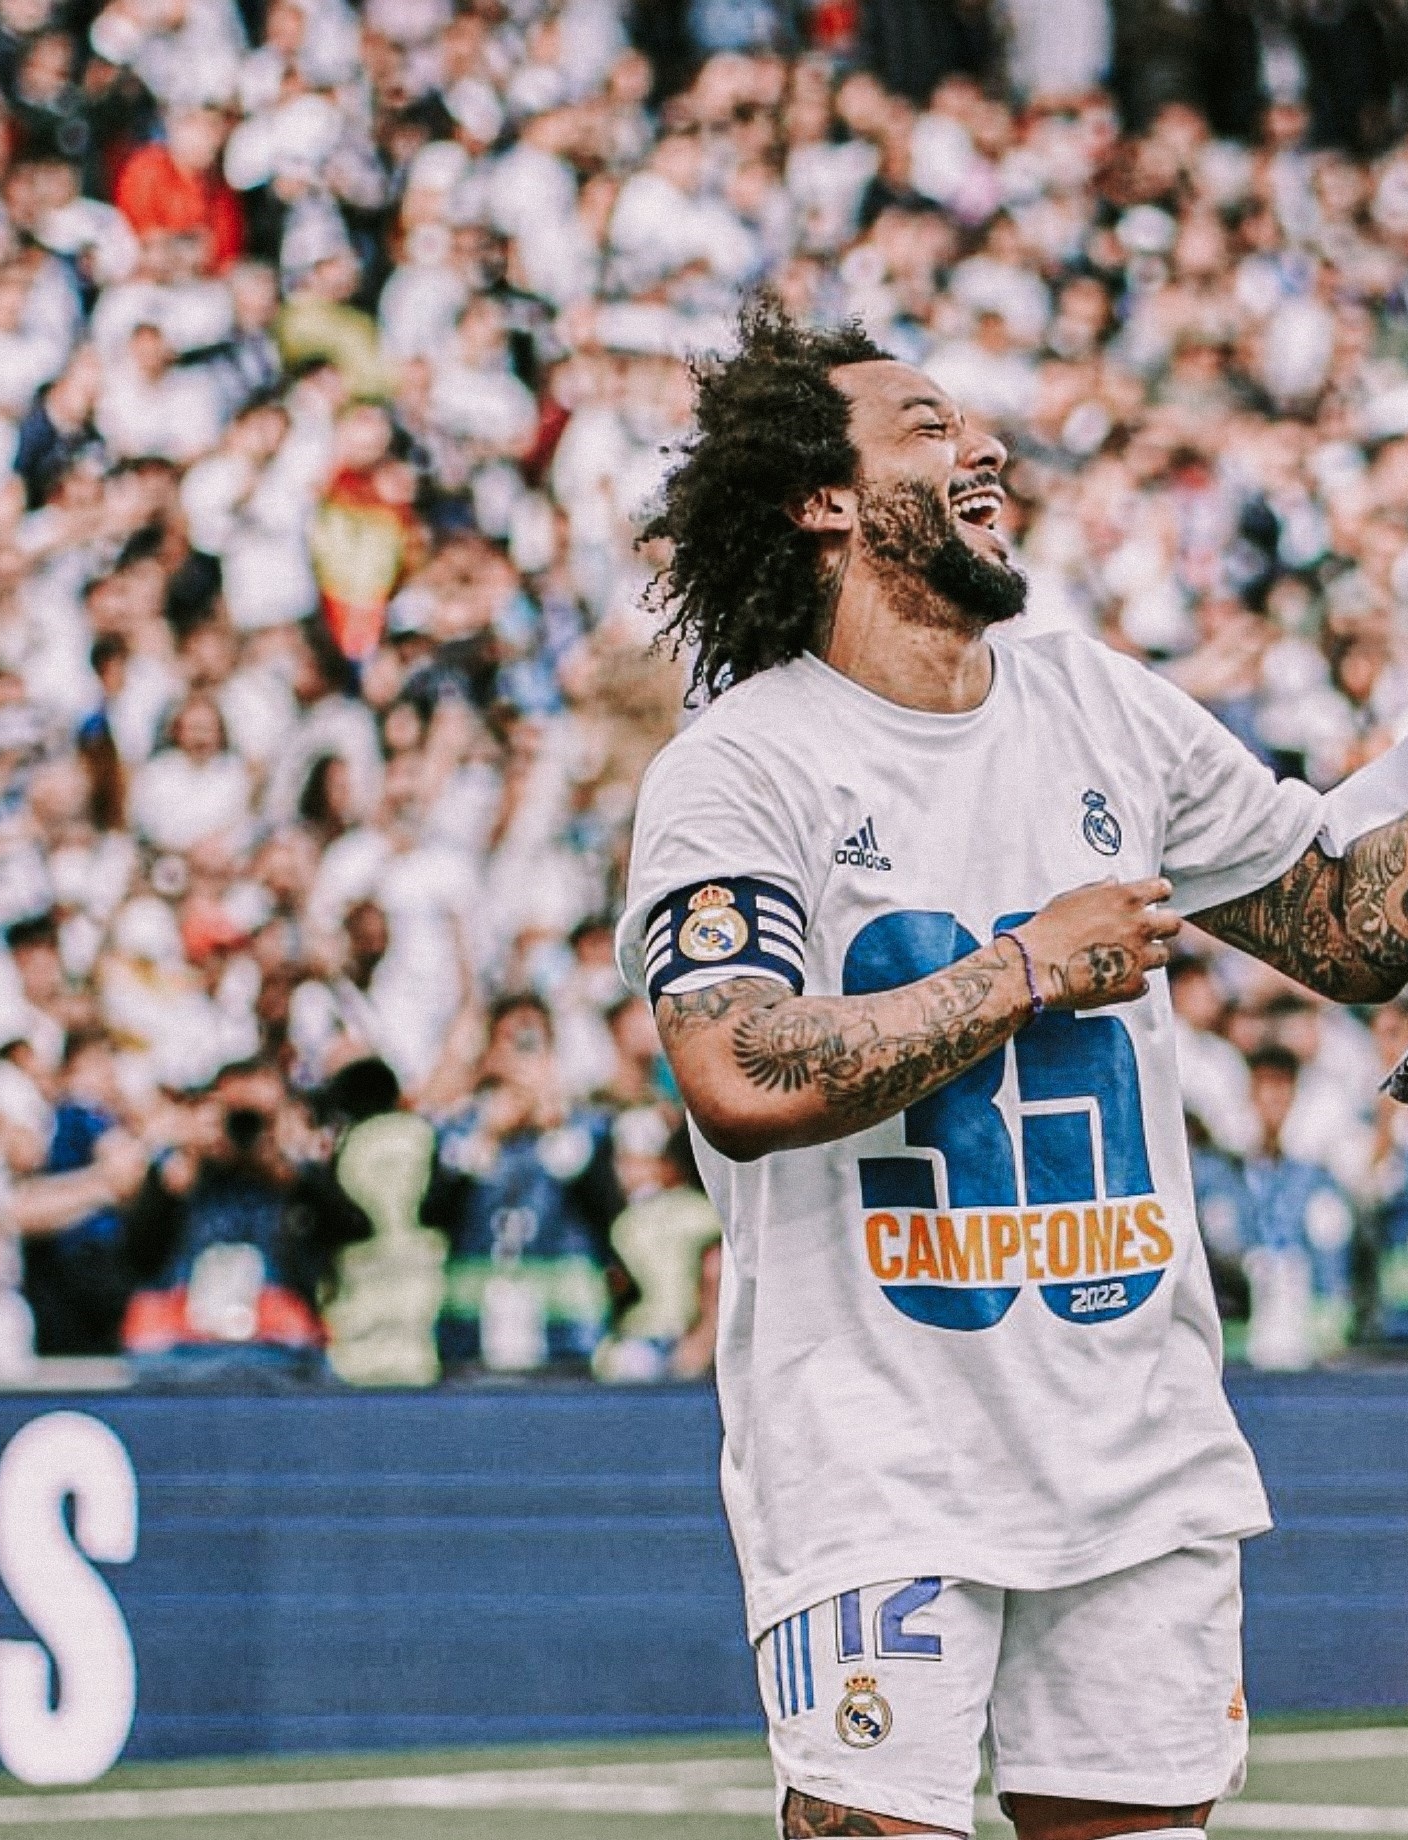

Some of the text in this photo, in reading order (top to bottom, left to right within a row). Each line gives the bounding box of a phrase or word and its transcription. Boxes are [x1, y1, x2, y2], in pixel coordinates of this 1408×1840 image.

[834, 847, 892, 872] adidas
[864, 1200, 1174, 1282] CAMPEONES
[1069, 1282, 1129, 1314] 2022
[834, 1574, 944, 1664] 12
